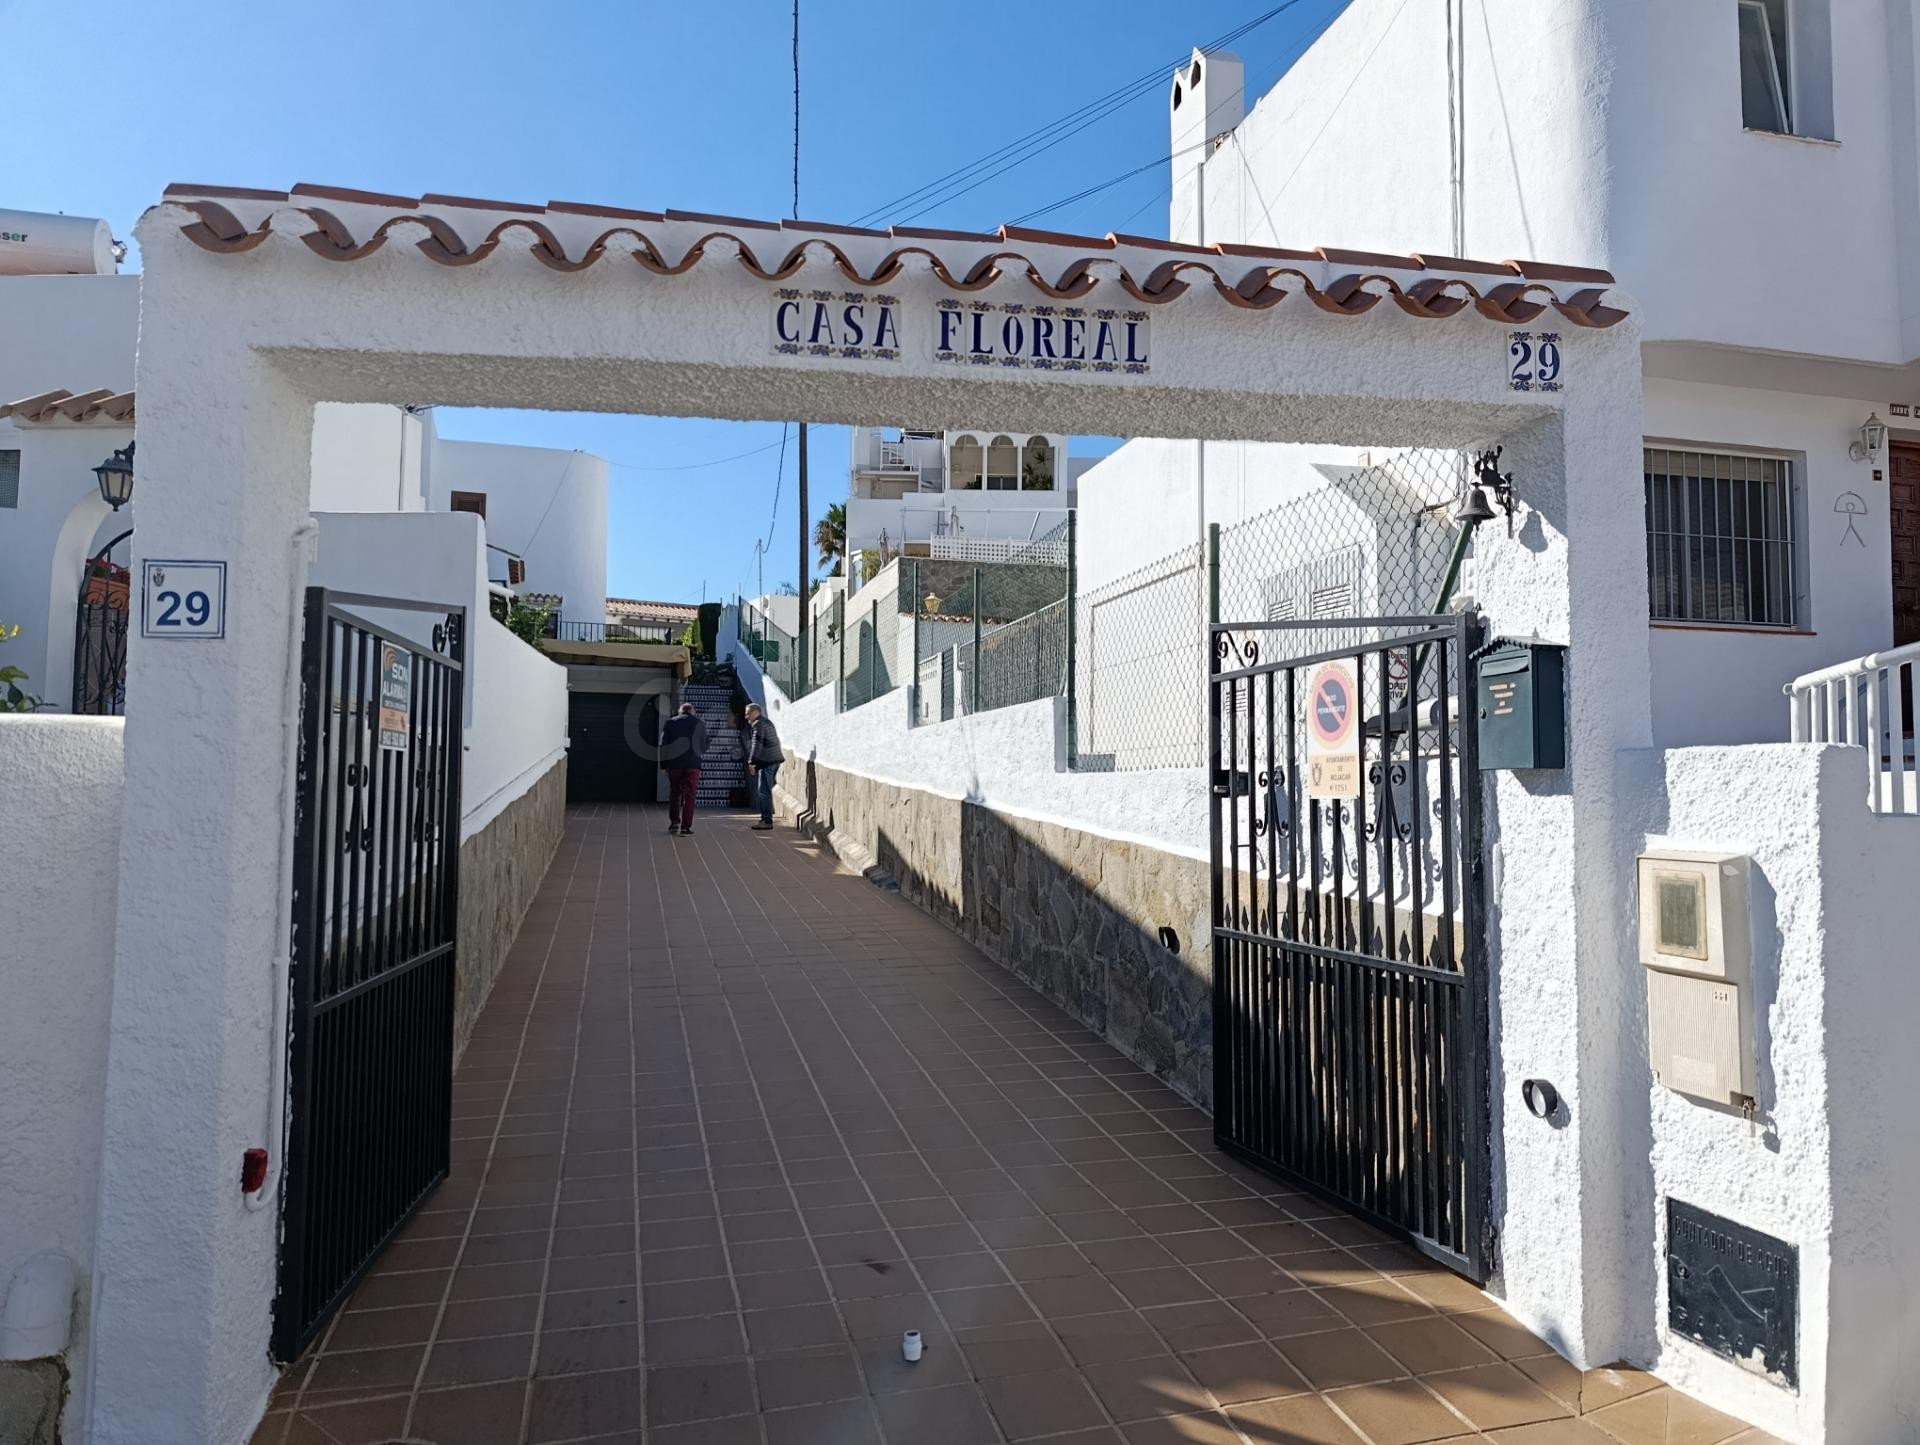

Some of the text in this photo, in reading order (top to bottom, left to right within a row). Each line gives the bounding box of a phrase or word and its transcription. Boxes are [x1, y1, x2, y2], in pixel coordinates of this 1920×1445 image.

[0, 231, 28, 242] ser
[776, 301, 1148, 362] CASA FLOREAL
[1511, 341, 1560, 381] 29
[156, 590, 210, 626] 29
[1738, 1240, 1752, 1264] DE
